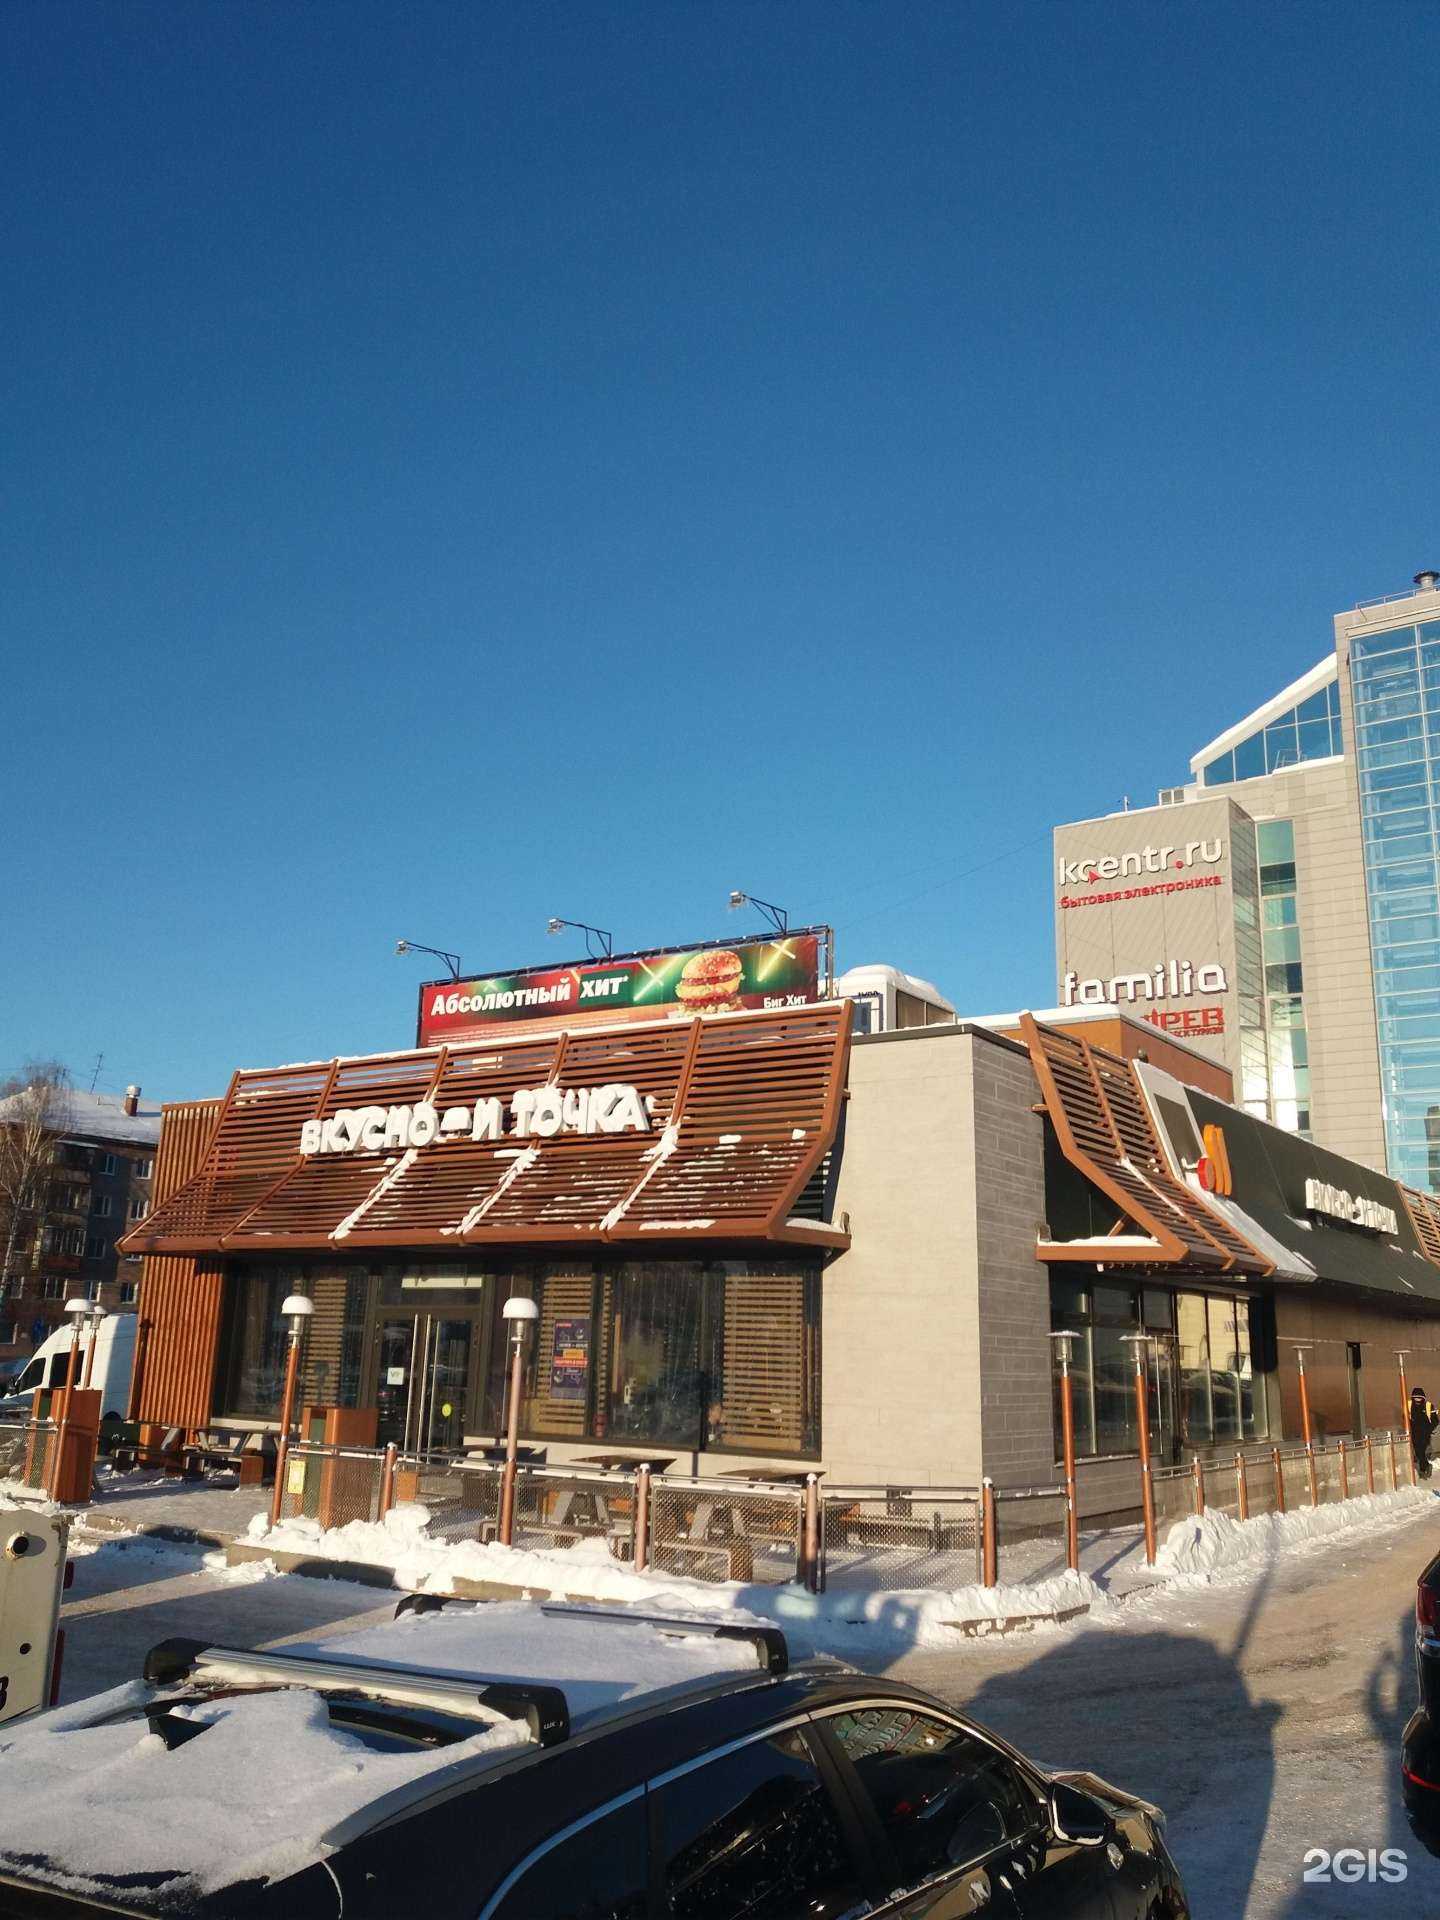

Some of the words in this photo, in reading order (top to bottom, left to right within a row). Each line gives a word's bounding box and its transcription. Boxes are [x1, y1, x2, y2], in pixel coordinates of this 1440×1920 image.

[1059, 837, 1223, 886] kcentr.ru
[430, 976, 571, 1017] Абсолютный
[1064, 959, 1228, 1006] familia
[300, 1101, 438, 1155] ВКУСНО
[510, 1083, 649, 1138] ТОЧКА
